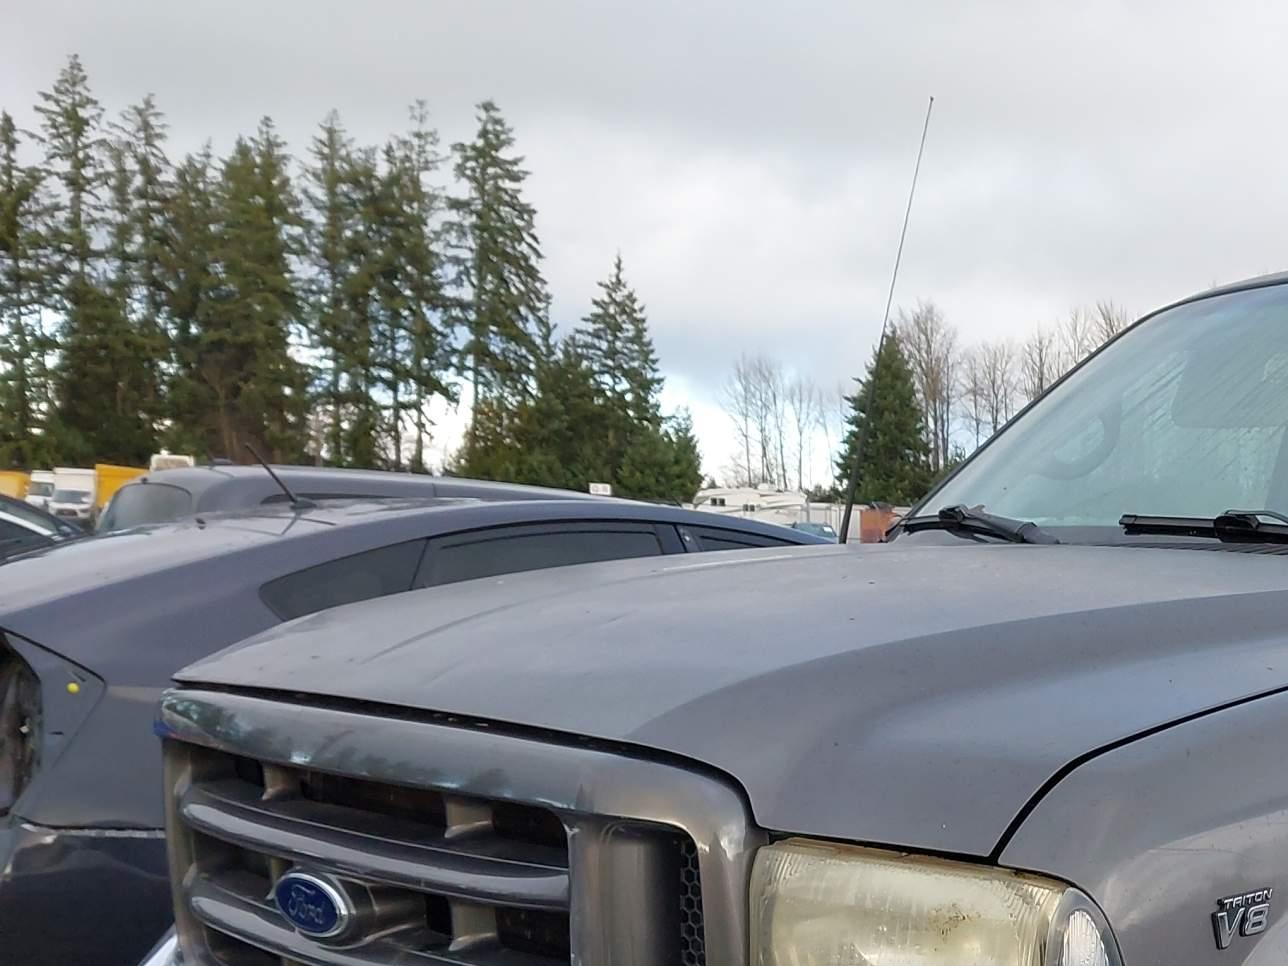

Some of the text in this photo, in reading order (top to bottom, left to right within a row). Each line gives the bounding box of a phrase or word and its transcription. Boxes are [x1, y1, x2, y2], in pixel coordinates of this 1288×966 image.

[289, 884, 325, 924] Ford
[1223, 888, 1273, 910] TRITON
[1217, 903, 1270, 948] V8
